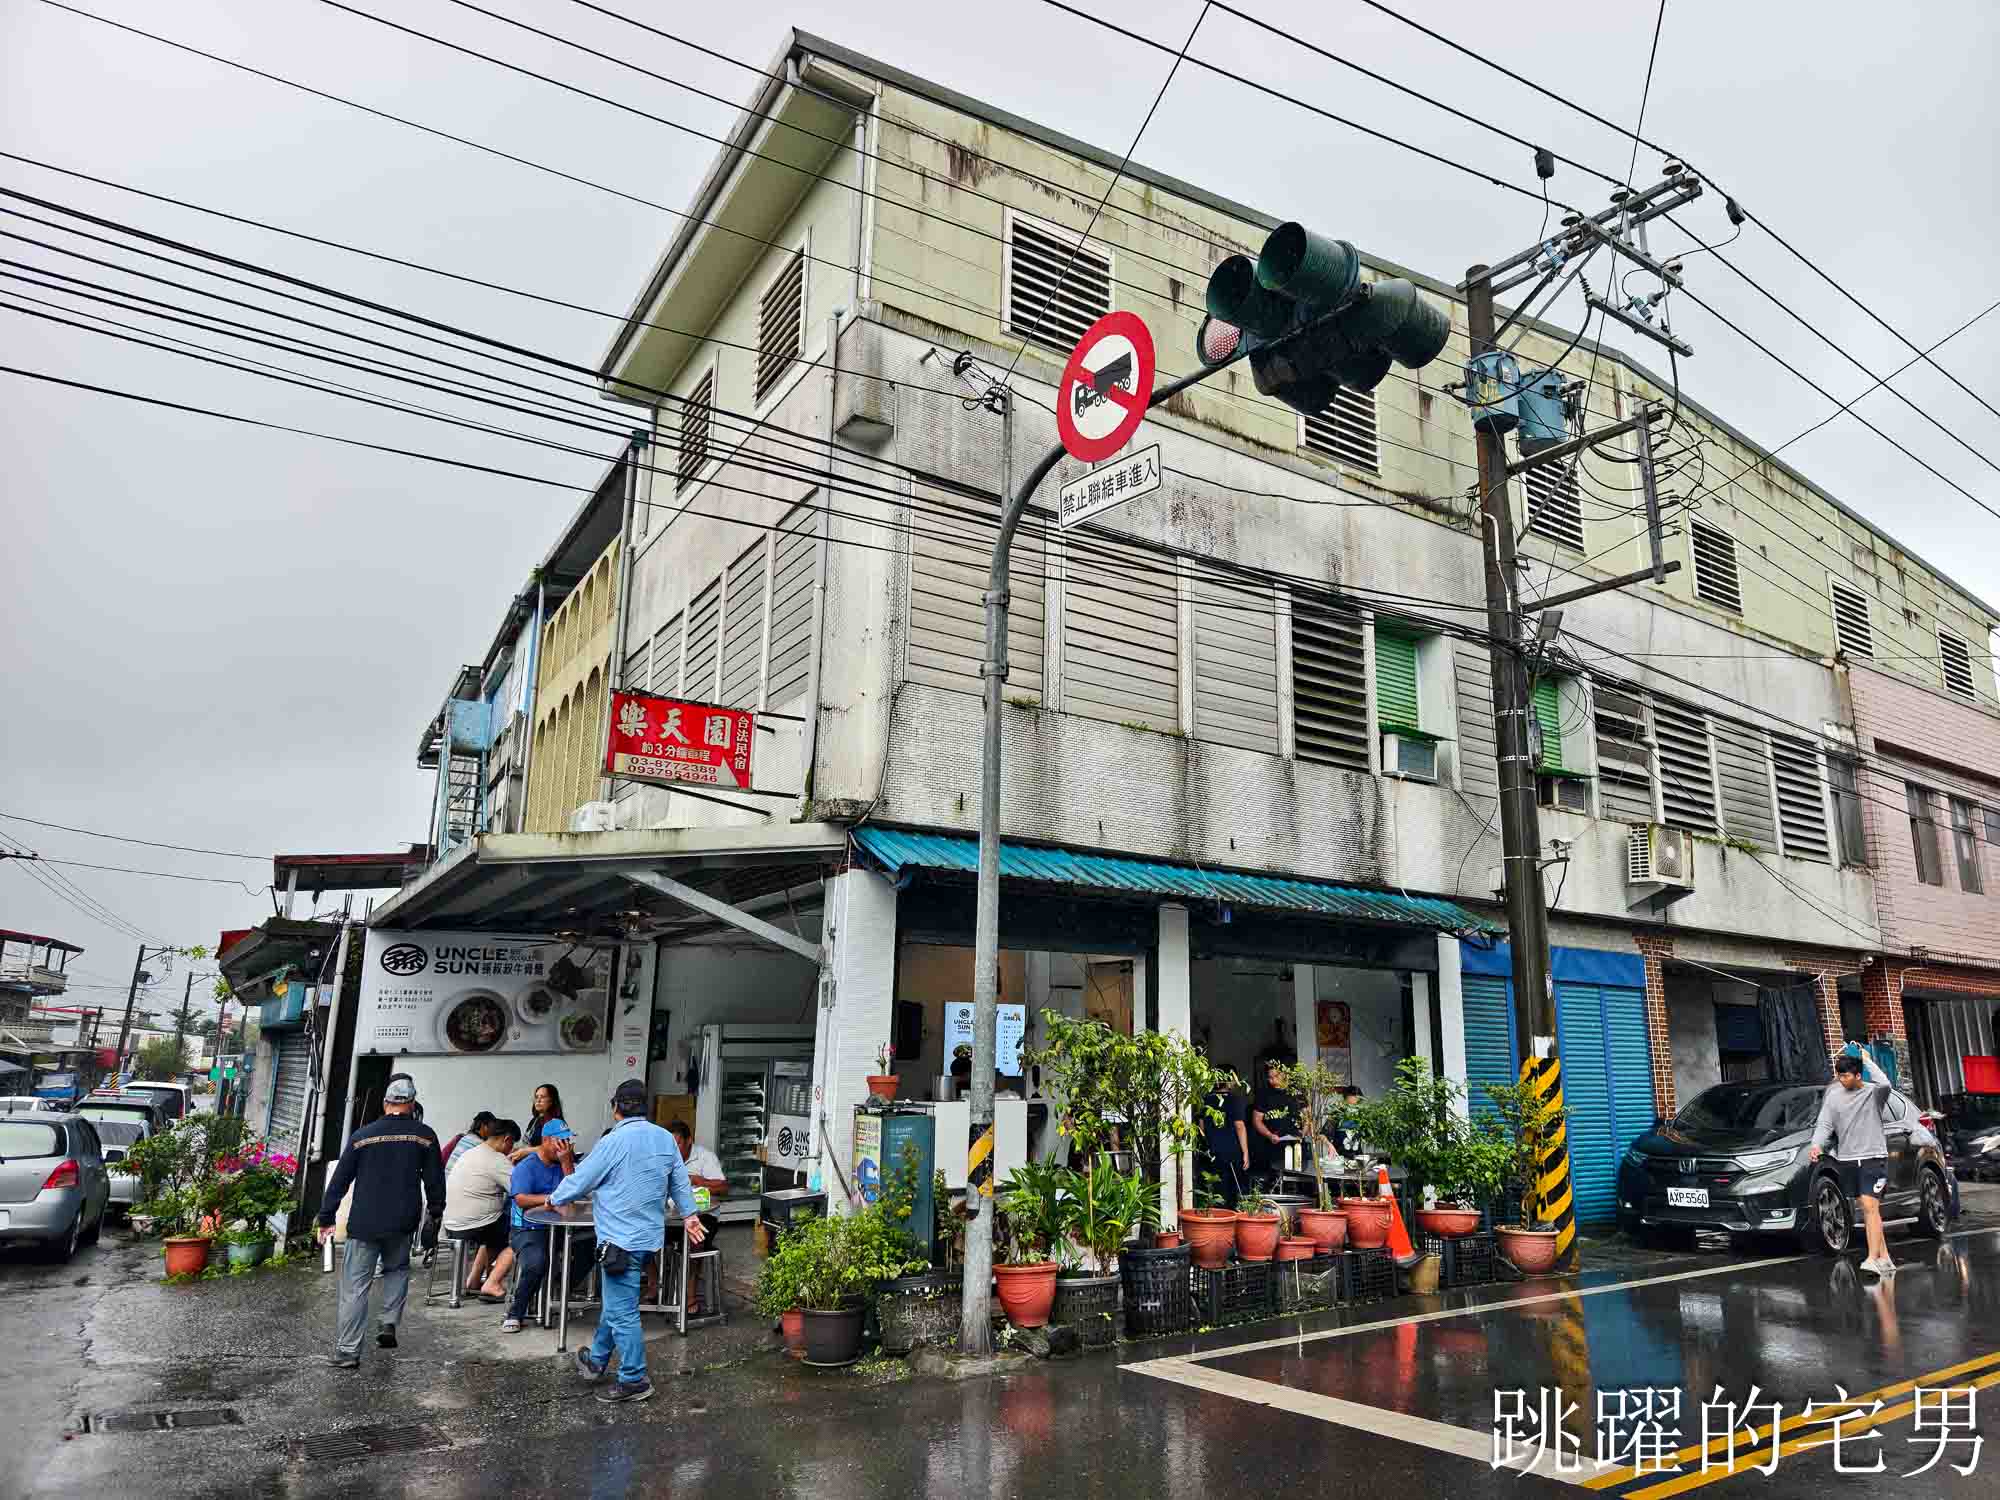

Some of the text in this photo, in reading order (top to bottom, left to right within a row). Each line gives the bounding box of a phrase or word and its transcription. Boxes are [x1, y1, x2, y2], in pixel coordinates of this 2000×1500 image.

[1063, 457, 1158, 517] 禁止聯結車進入
[616, 700, 732, 750] 樂天園
[627, 765, 718, 783] 0937954946
[630, 756, 717, 775] 03-8772389
[434, 947, 508, 961] UNCLE
[434, 961, 480, 975] SUN
[1669, 1191, 1708, 1204] AXP-5560
